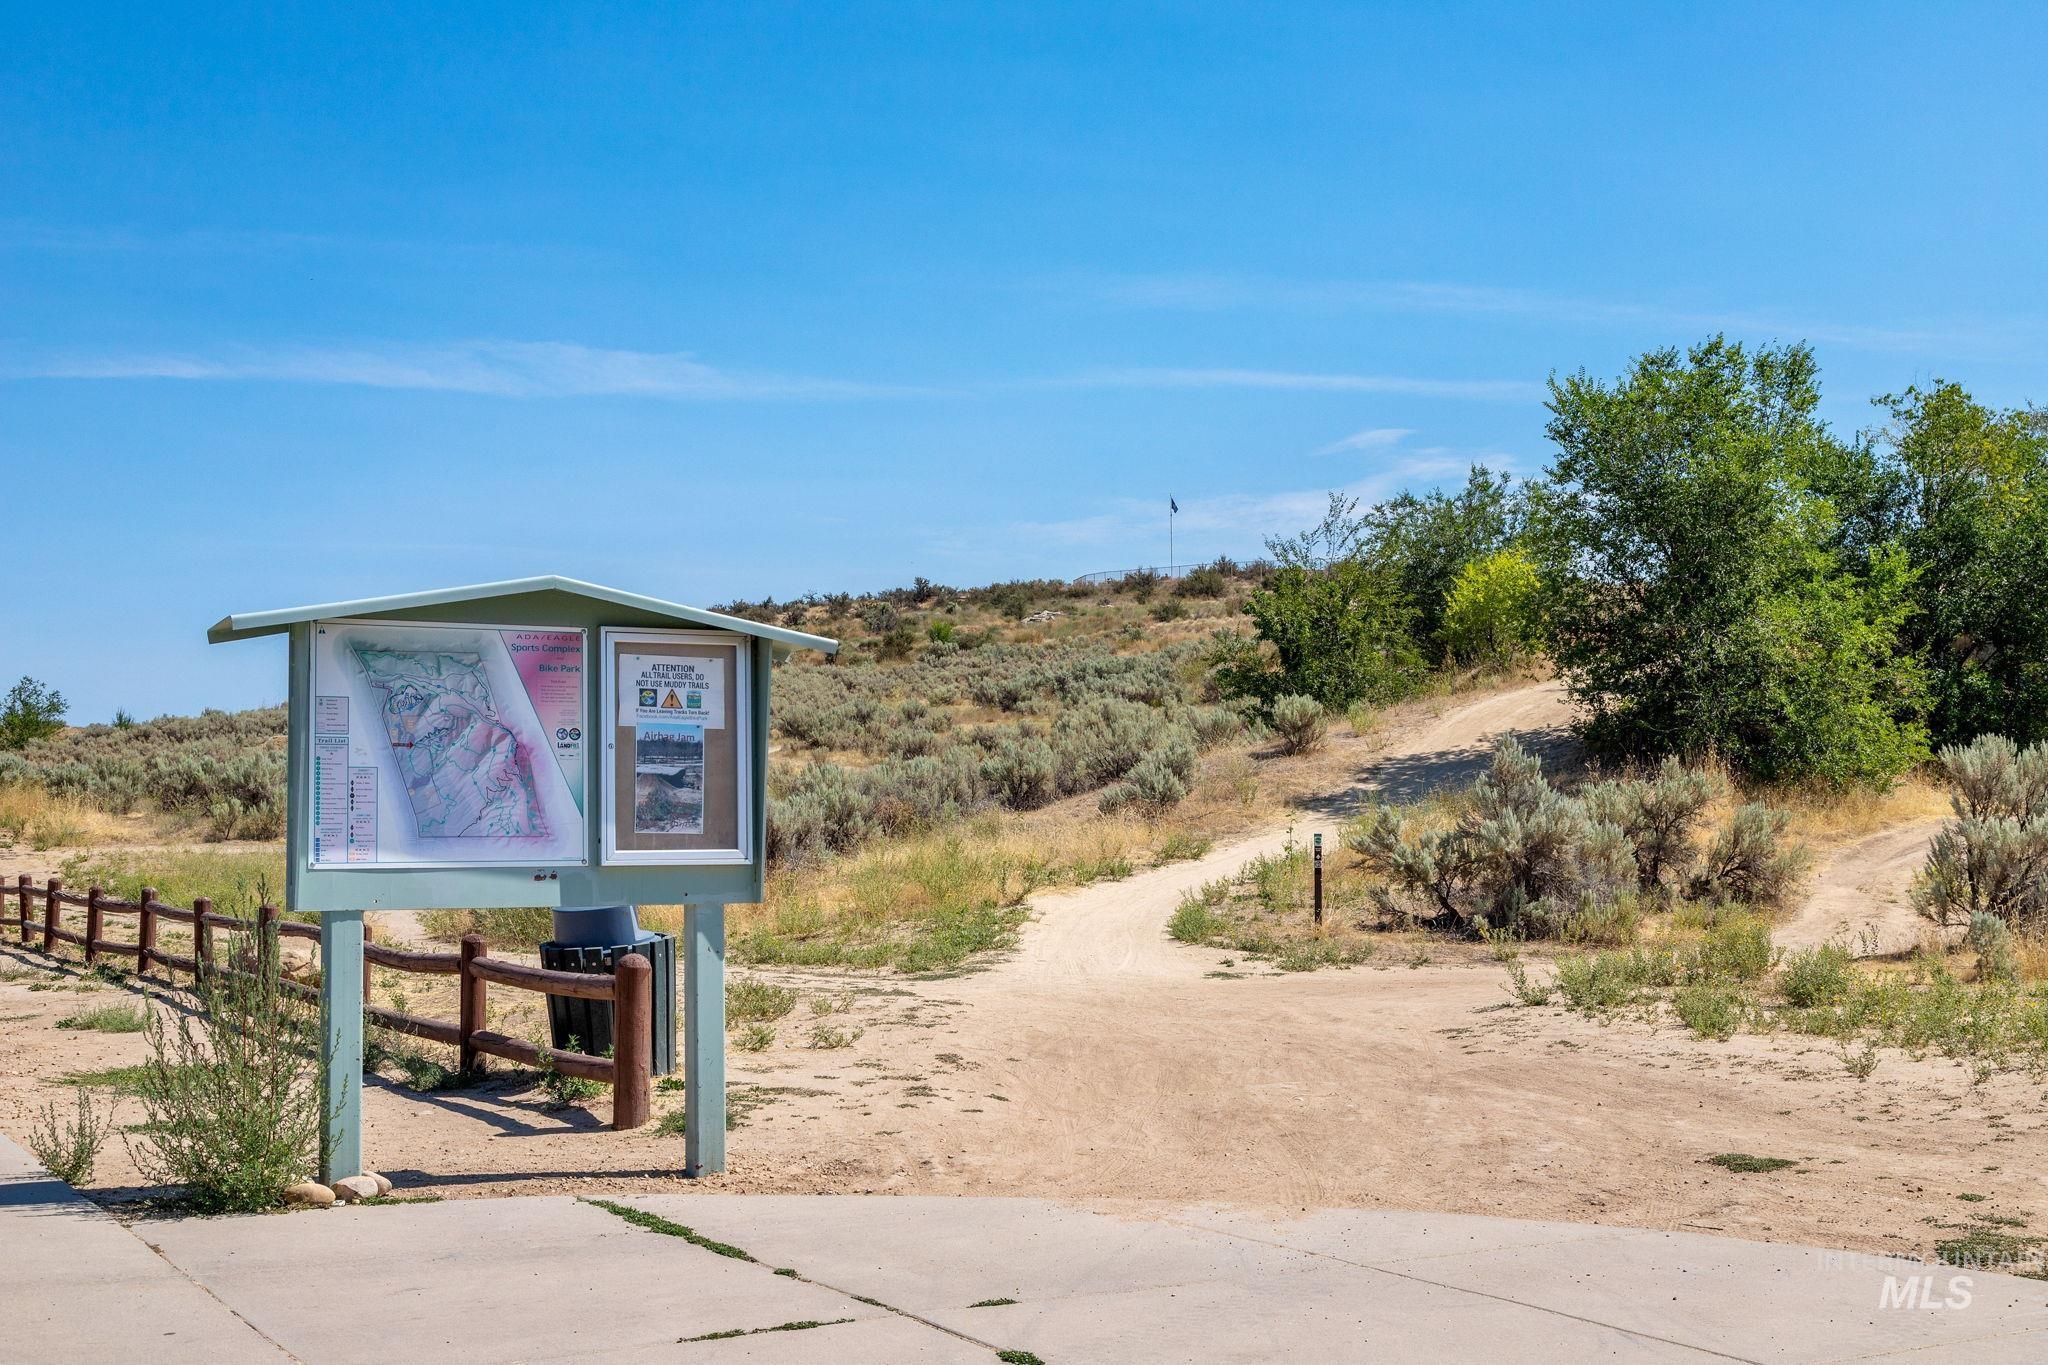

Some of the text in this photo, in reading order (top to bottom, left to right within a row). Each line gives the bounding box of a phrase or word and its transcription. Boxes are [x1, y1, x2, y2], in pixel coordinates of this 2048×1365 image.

[511, 643, 581, 653] Sports Complex
[539, 664, 581, 672] Bike Park
[651, 664, 695, 672] ATTENTION
[672, 673, 694, 681] USERS,
[644, 731, 695, 742] Airbag Jam
